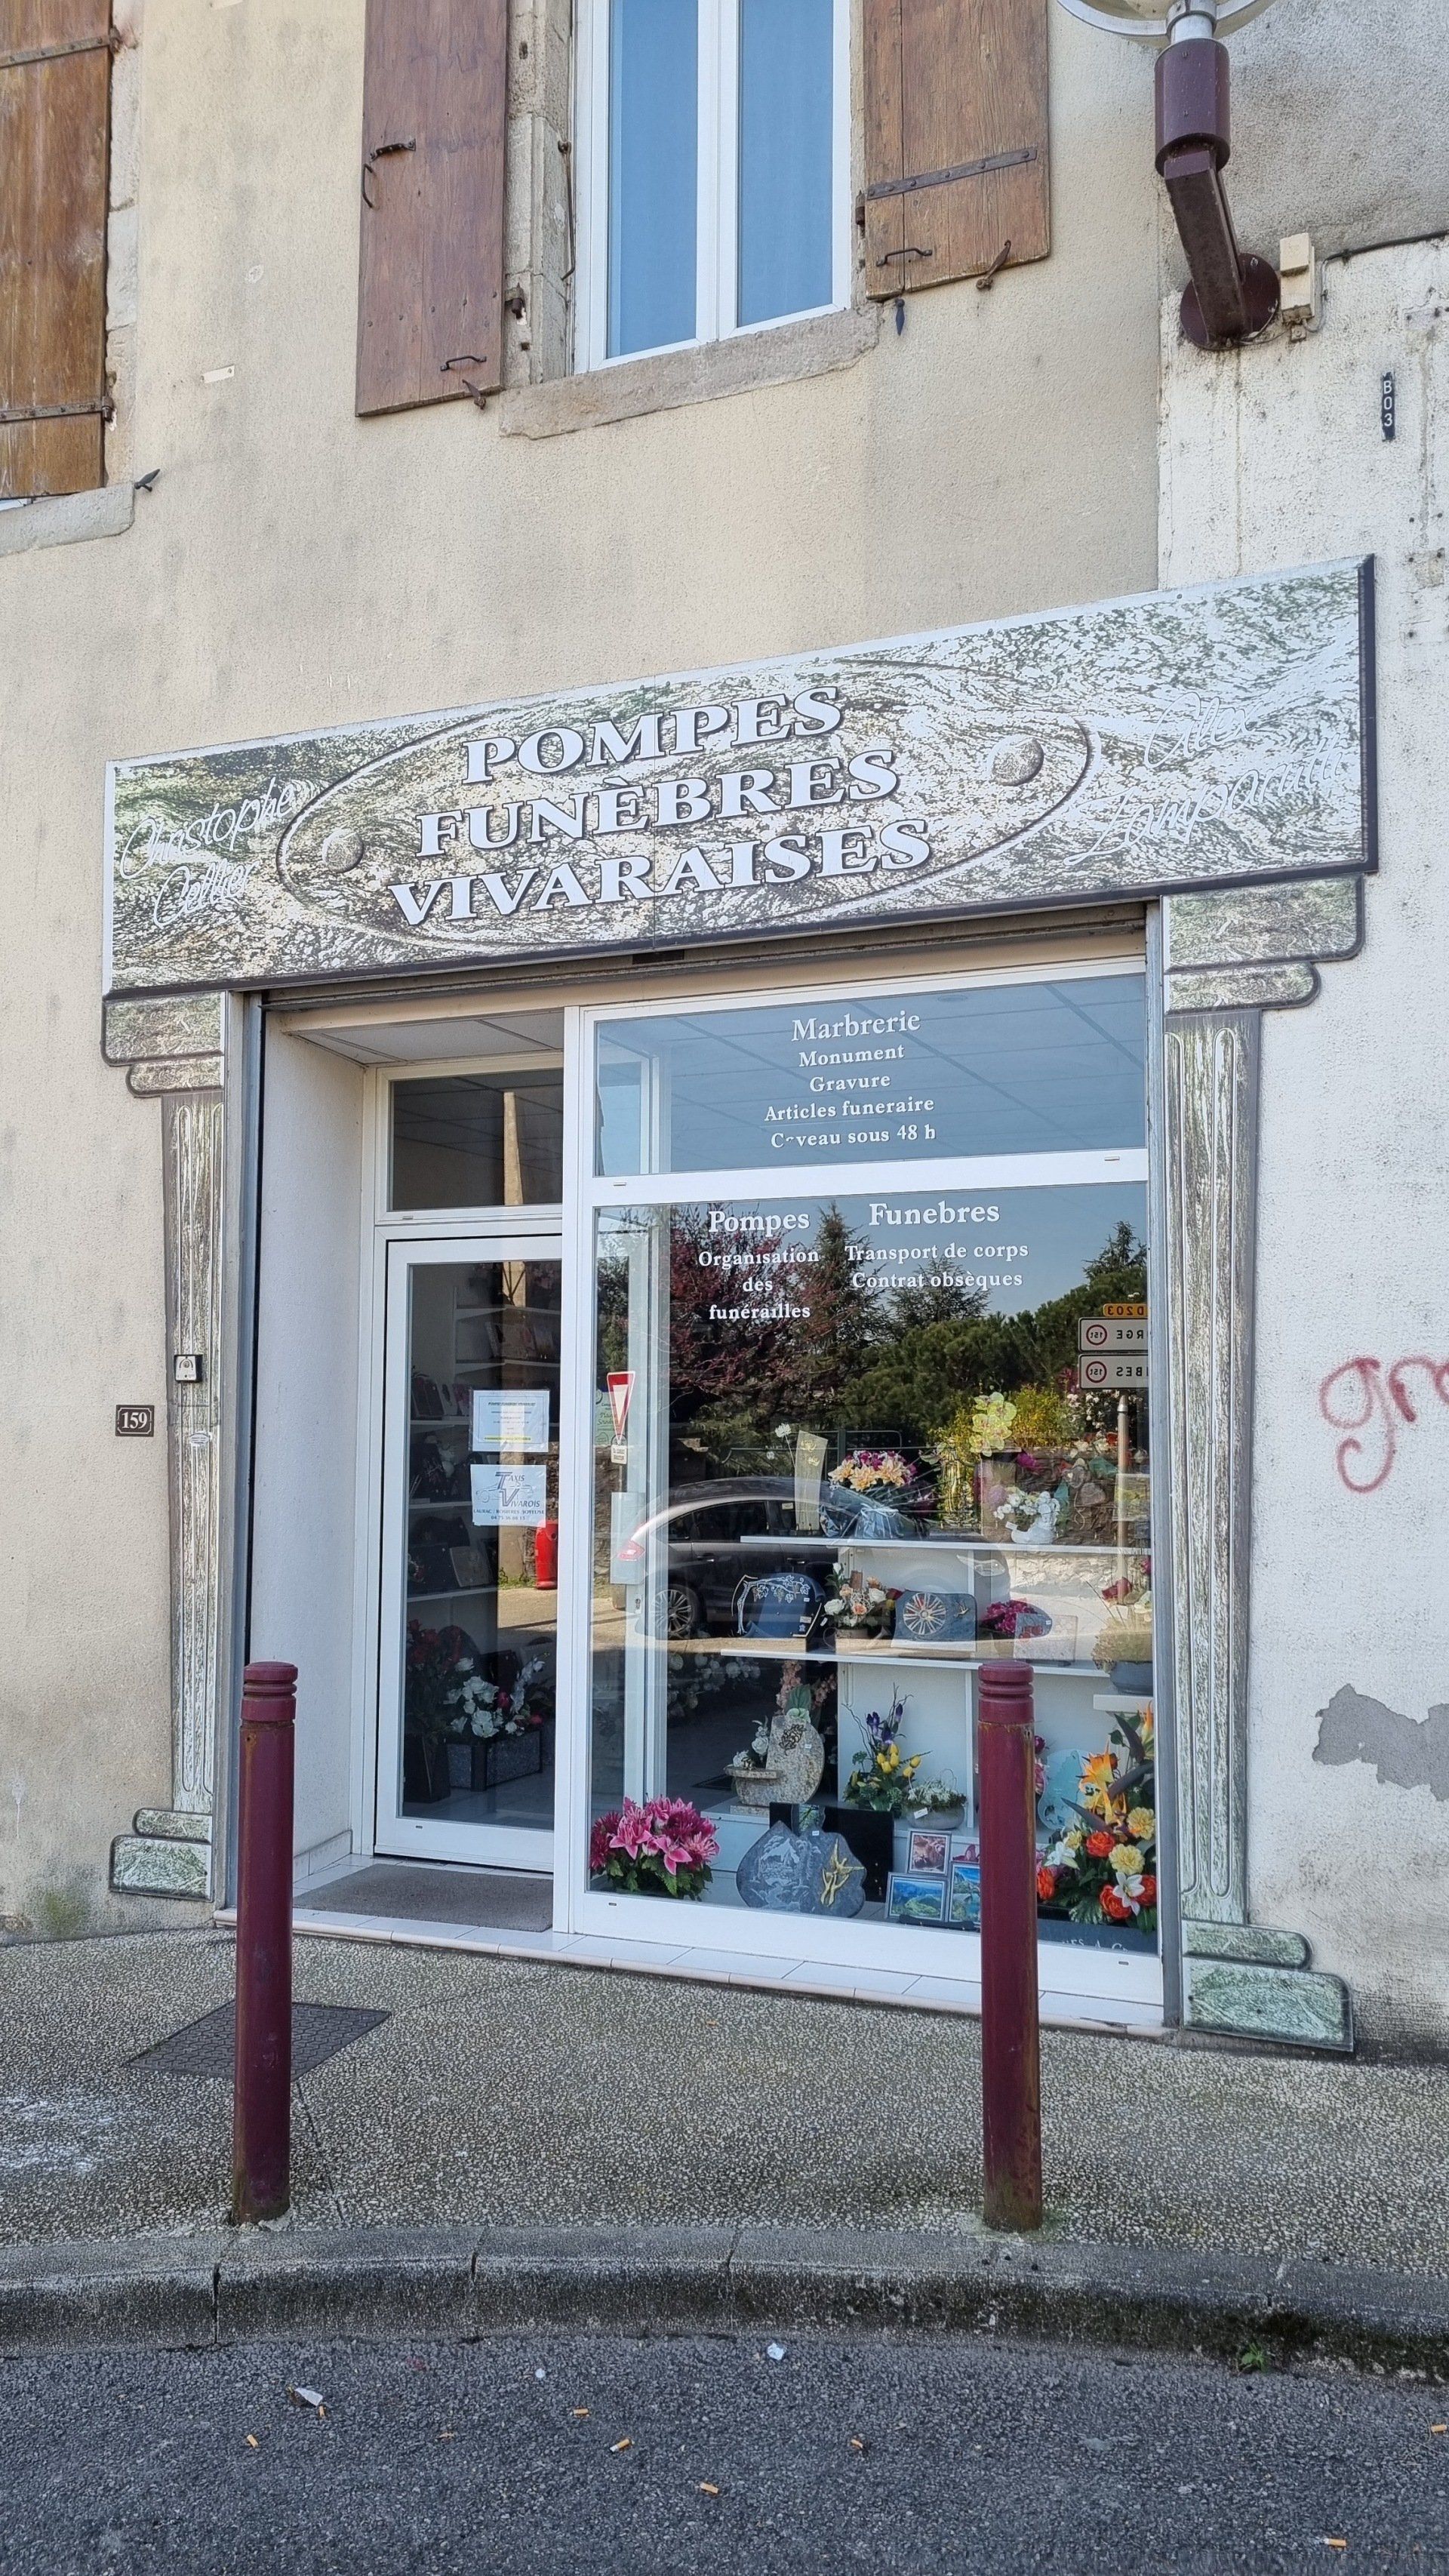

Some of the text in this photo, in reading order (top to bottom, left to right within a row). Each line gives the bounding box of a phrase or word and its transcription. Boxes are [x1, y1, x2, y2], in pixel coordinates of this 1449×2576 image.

[1383, 380, 1392, 426] B03
[462, 685, 844, 786] POMPES
[1144, 691, 1263, 768] Alex
[415, 749, 900, 858] FUNÈBRES
[120, 777, 295, 879] Christophe
[388, 818, 932, 927] VIVARAISES
[791, 1010, 921, 1042] Marbrerie
[798, 1044, 905, 1067] Monument
[809, 1075, 891, 1093] Gravure
[764, 1096, 934, 1122] Articles funeraire
[848, 1130, 890, 1143] sous
[897, 1124, 918, 1141] 48
[924, 1125, 936, 1140] h
[708, 1201, 1001, 1238] Pompes Funebres
[698, 1247, 820, 1270] Organisation
[844, 1242, 1029, 1264] Transport de corps
[743, 1277, 773, 1292] des
[852, 1271, 1023, 1291] Contrat obsèques
[709, 1301, 811, 1320] funérailles
[122, 1411, 148, 1430] 159
[499, 1488, 540, 1507] VIVAROIS
